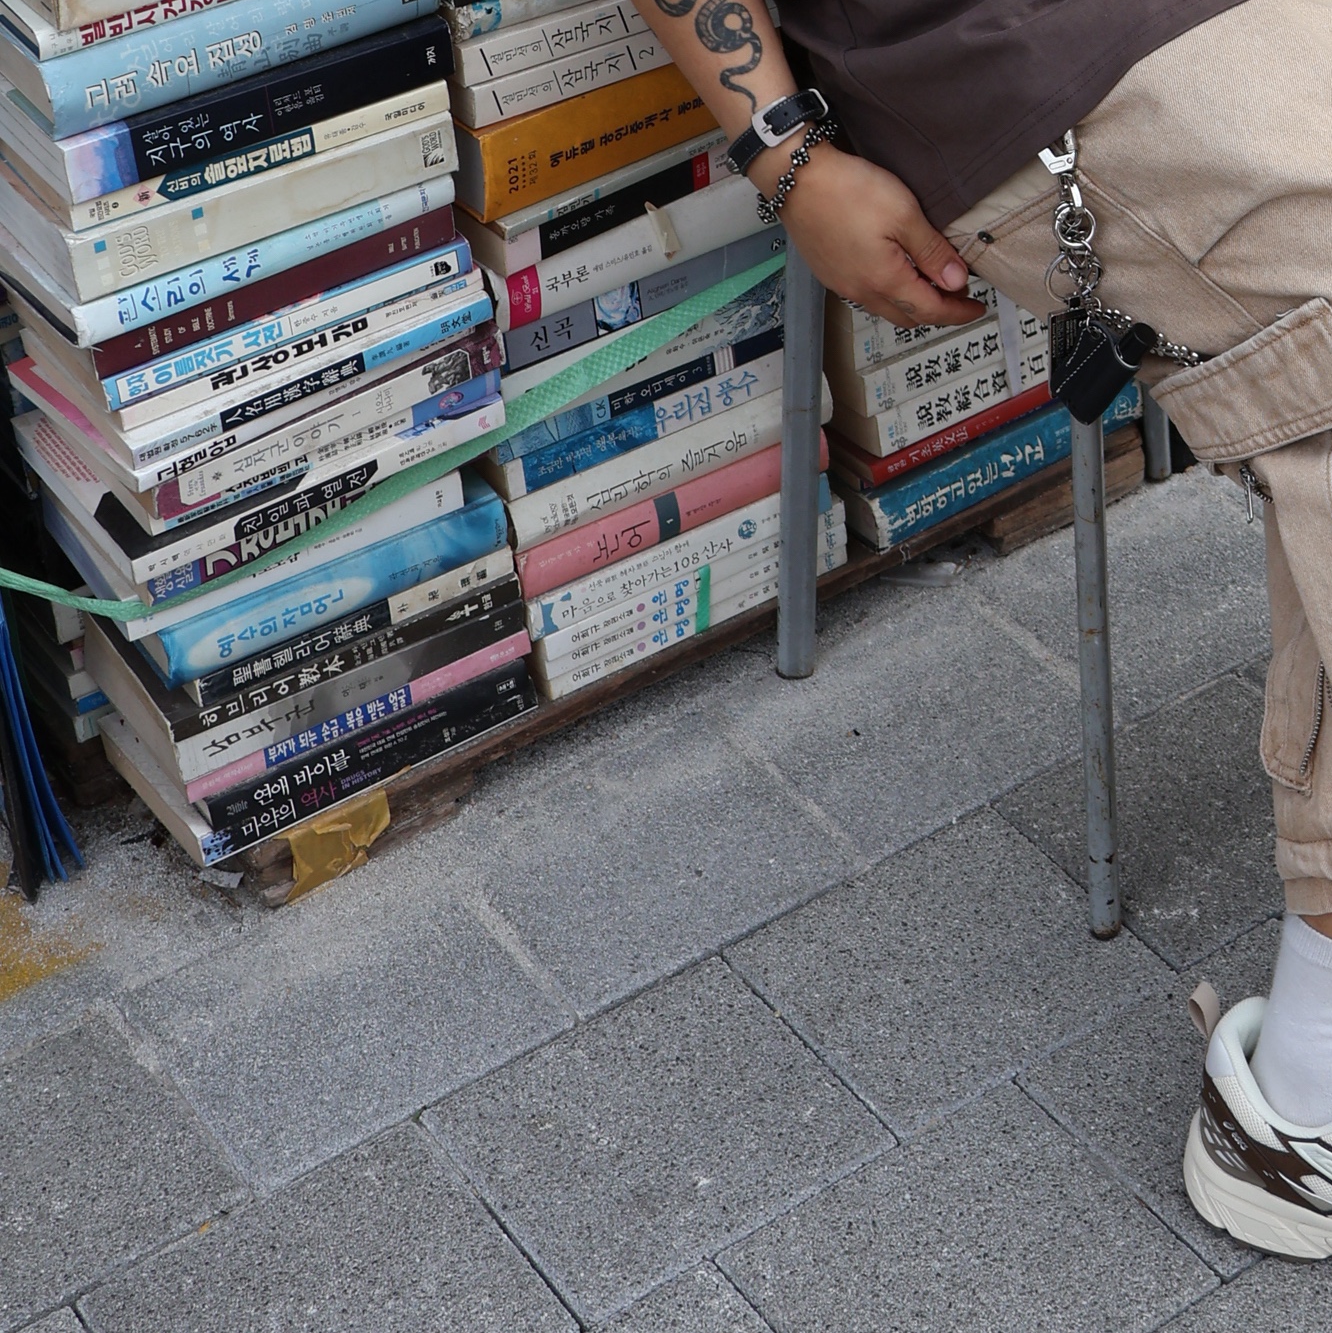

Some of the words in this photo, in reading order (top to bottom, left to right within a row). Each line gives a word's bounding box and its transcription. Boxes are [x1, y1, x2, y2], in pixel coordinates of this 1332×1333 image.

[490, 39, 544, 66] 설민석의
[551, 14, 618, 50] 삼국지
[86, 70, 139, 110] 고려
[502, 78, 555, 107] 설민석의
[561, 53, 627, 90] 삼국지
[638, 45, 655, 61] 2
[219, 111, 265, 142] 역사
[549, 138, 596, 170] 에듀윌
[599, 108, 674, 148] 공인중개사
[507, 156, 520, 195] 2021
[221, 248, 261, 282] 세계
[545, 264, 591, 293] 국부론
[155, 340, 234, 385] 이름짓기
[243, 320, 284, 350] 사전
[209, 316, 369, 391] 관상보감
[529, 317, 576, 353] 신곡
[655, 386, 712, 434] 우리집
[715, 370, 760, 406] 풍수
[586, 463, 675, 512] 심리학의
[680, 429, 748, 472] 즐거움
[253, 775, 291, 806] 연애
[294, 748, 351, 786] 바이블
[241, 798, 297, 838] 마약의
[300, 781, 338, 809] 역사
